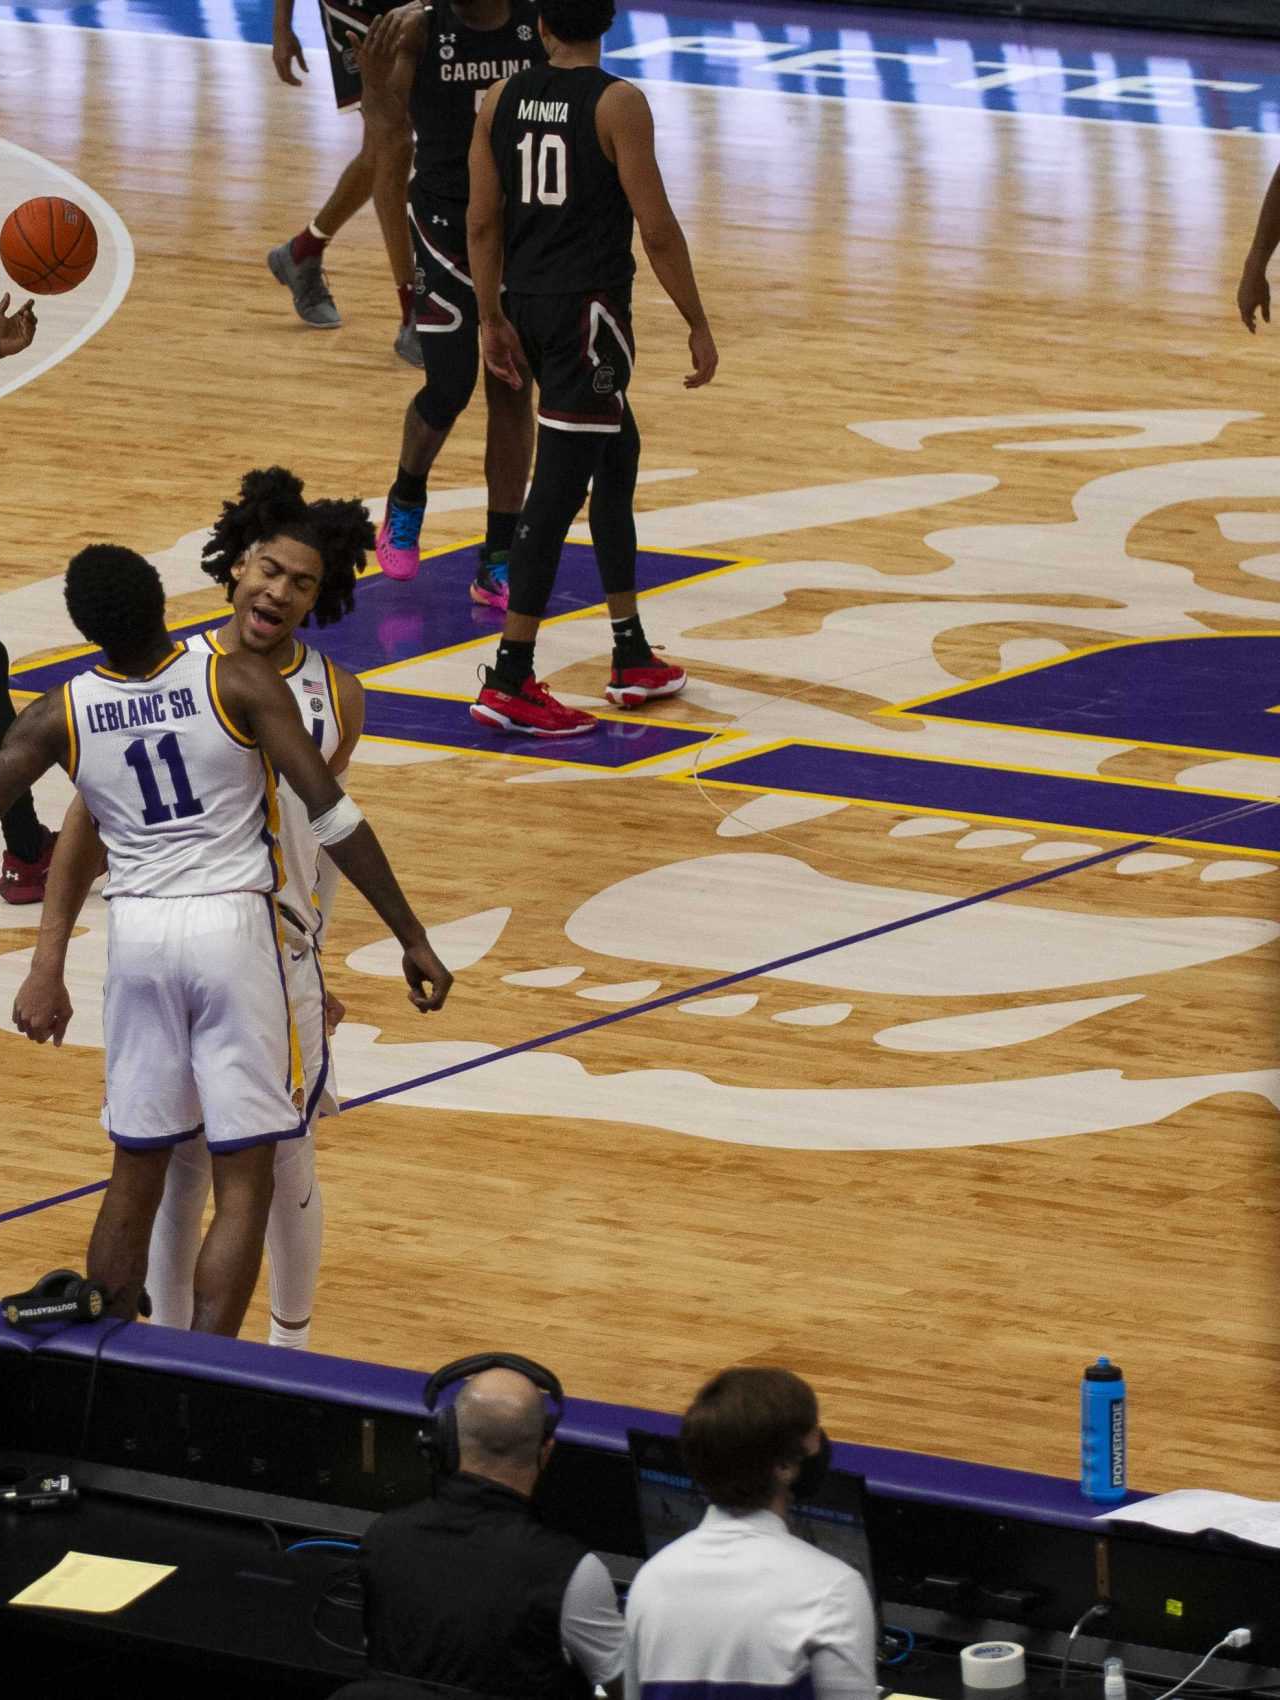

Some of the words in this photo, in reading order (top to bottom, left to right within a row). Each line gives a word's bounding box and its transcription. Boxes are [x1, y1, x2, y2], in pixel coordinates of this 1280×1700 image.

[440, 59, 531, 82] CAROLINA
[517, 99, 568, 123] MINAYA
[516, 132, 567, 206] 10
[86, 693, 166, 734] LEBLANC
[169, 687, 201, 719] SR.
[124, 732, 205, 826] 11
[19, 1302, 78, 1316] SOUTHEASTERN
[1112, 1402, 1124, 1485] POWERADE
